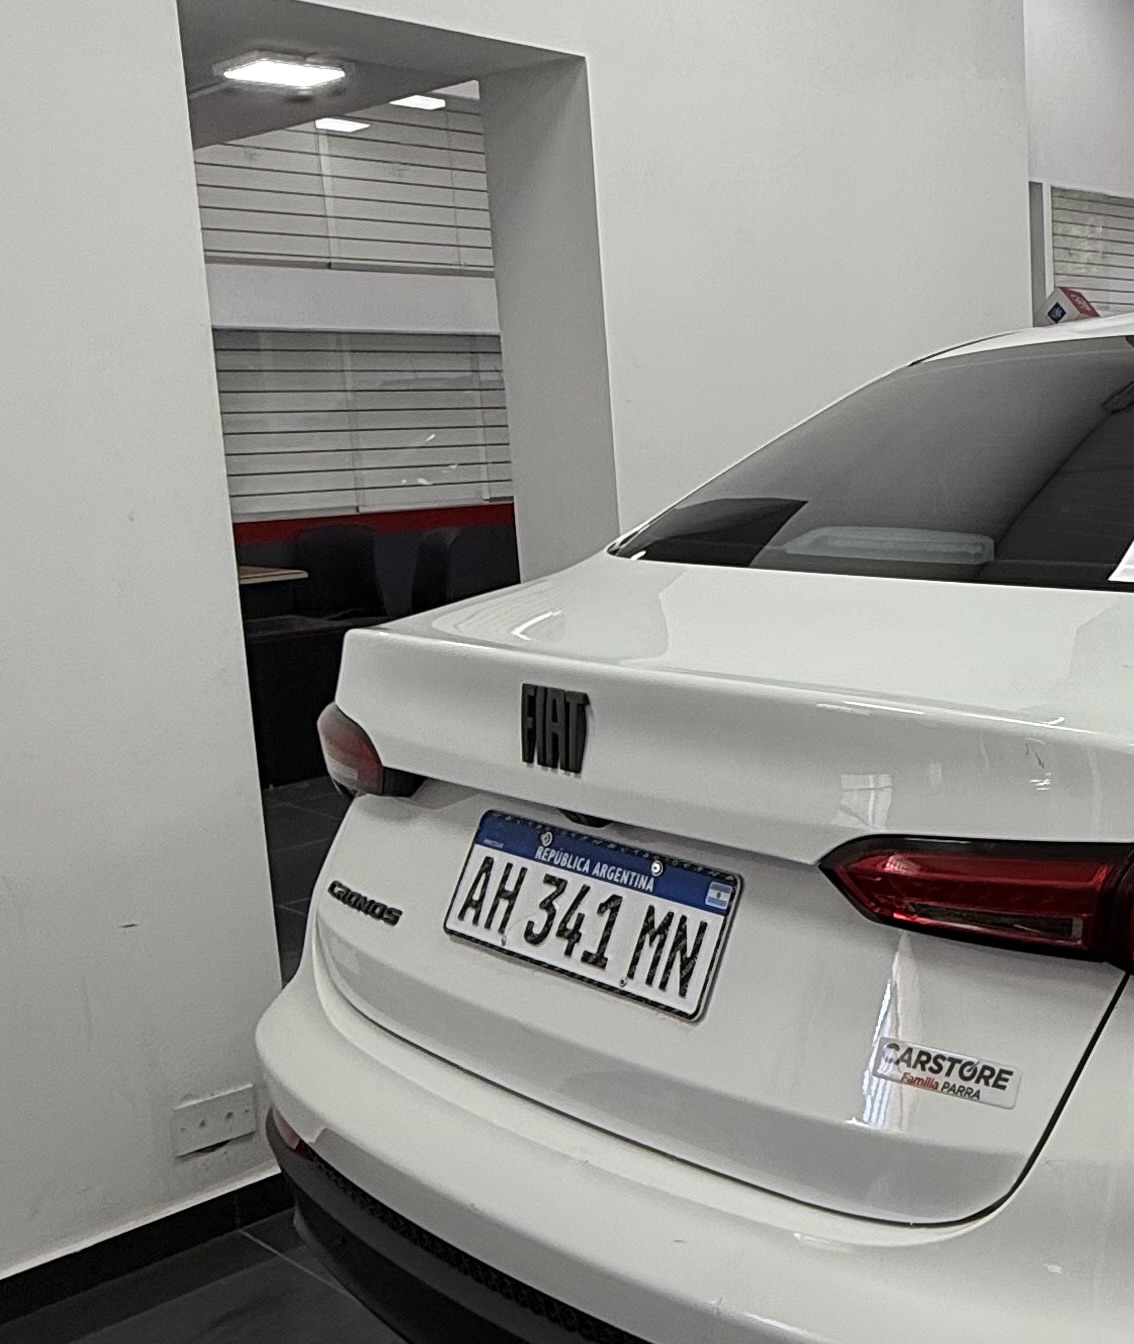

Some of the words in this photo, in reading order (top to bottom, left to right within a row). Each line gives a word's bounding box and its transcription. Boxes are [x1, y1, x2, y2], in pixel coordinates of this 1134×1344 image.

[521, 683, 591, 774] FIAT
[534, 845, 591, 874] REPÚBLICA
[591, 864, 655, 893] ARGENTINA
[327, 880, 403, 926] CRONOS
[457, 856, 528, 934] AH
[524, 874, 624, 970] 341
[627, 904, 708, 998] MN
[883, 1042, 1014, 1091] CARSTORE
[901, 1071, 940, 1090] Familia
[940, 1081, 981, 1100] PARRA
